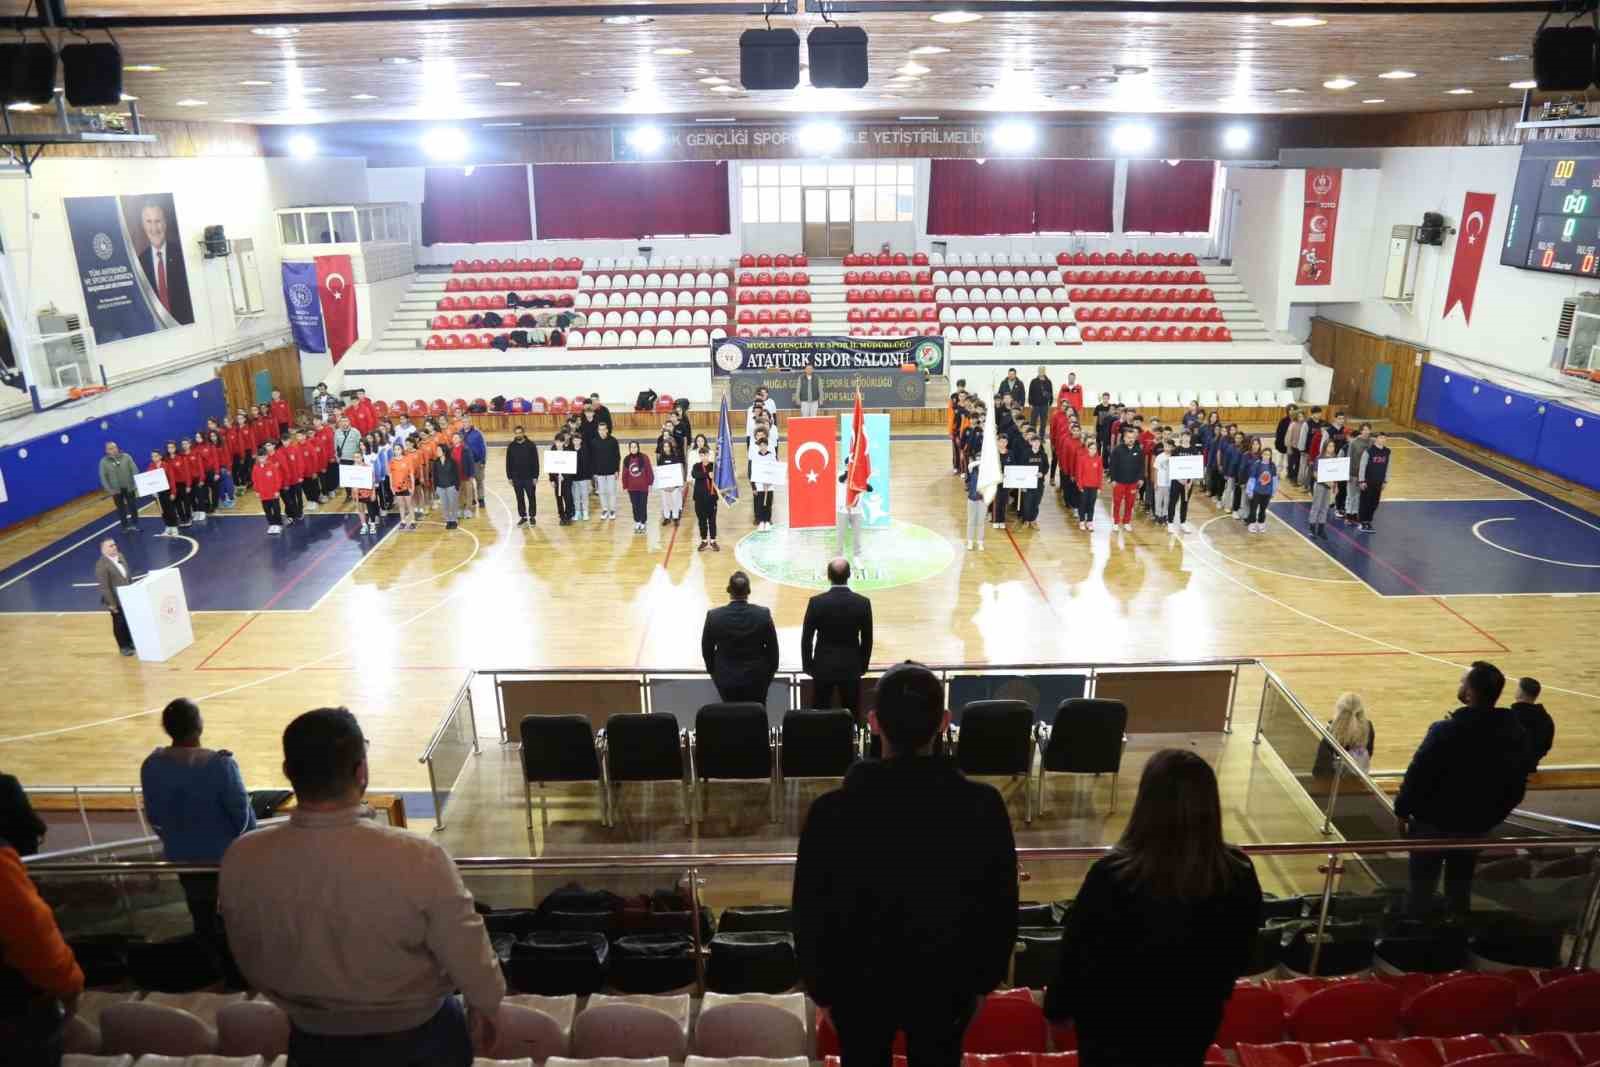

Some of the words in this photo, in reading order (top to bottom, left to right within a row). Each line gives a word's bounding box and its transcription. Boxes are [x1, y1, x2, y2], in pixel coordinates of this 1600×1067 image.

[686, 129, 749, 149] GENÇLİĞİ
[873, 127, 985, 147] YETİŞTİRİLMELİD
[1555, 160, 1575, 178] 00
[1563, 218, 1576, 236] 0
[1542, 250, 1553, 267] 0
[1582, 255, 1594, 272] 0
[747, 350, 811, 368] ATATÜRK
[814, 352, 850, 367] SPOR
[854, 352, 910, 367] SALONU
